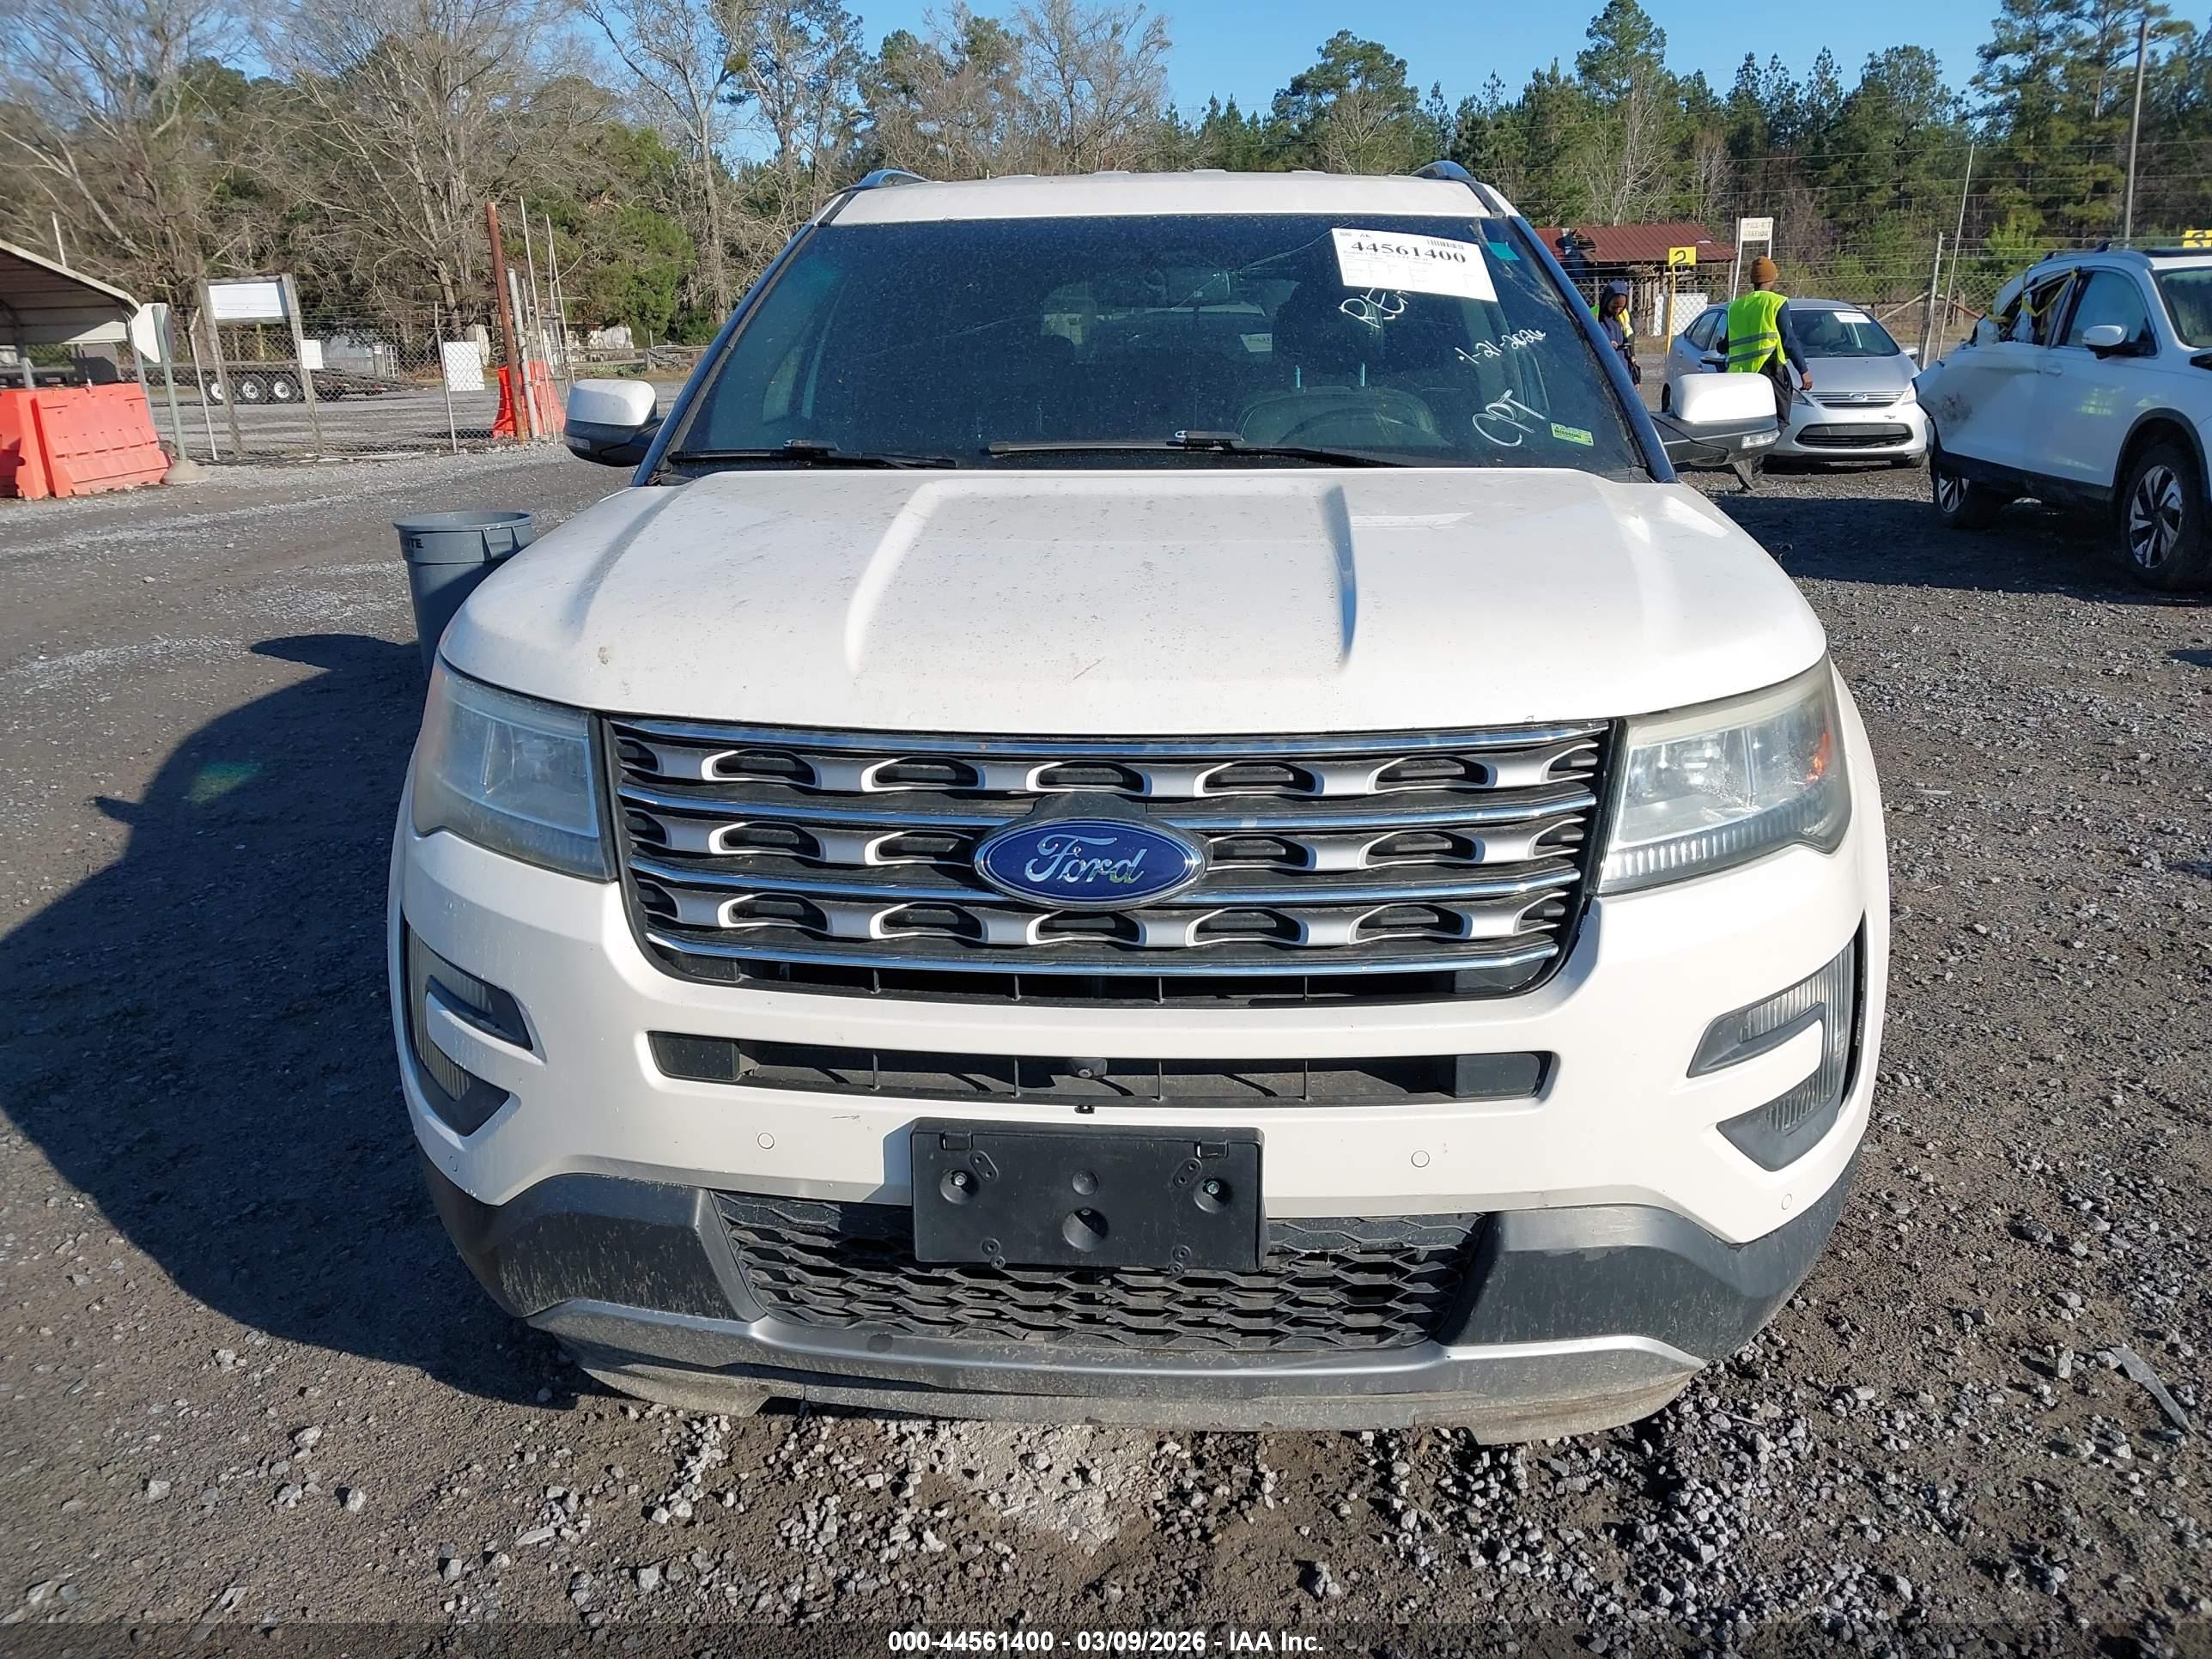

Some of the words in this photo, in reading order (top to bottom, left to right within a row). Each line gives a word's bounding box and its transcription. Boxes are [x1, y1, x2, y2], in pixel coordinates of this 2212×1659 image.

[1351, 241, 1466, 264] 44561400
[1671, 250, 1691, 265] 2
[1025, 834, 1148, 884] Ford
